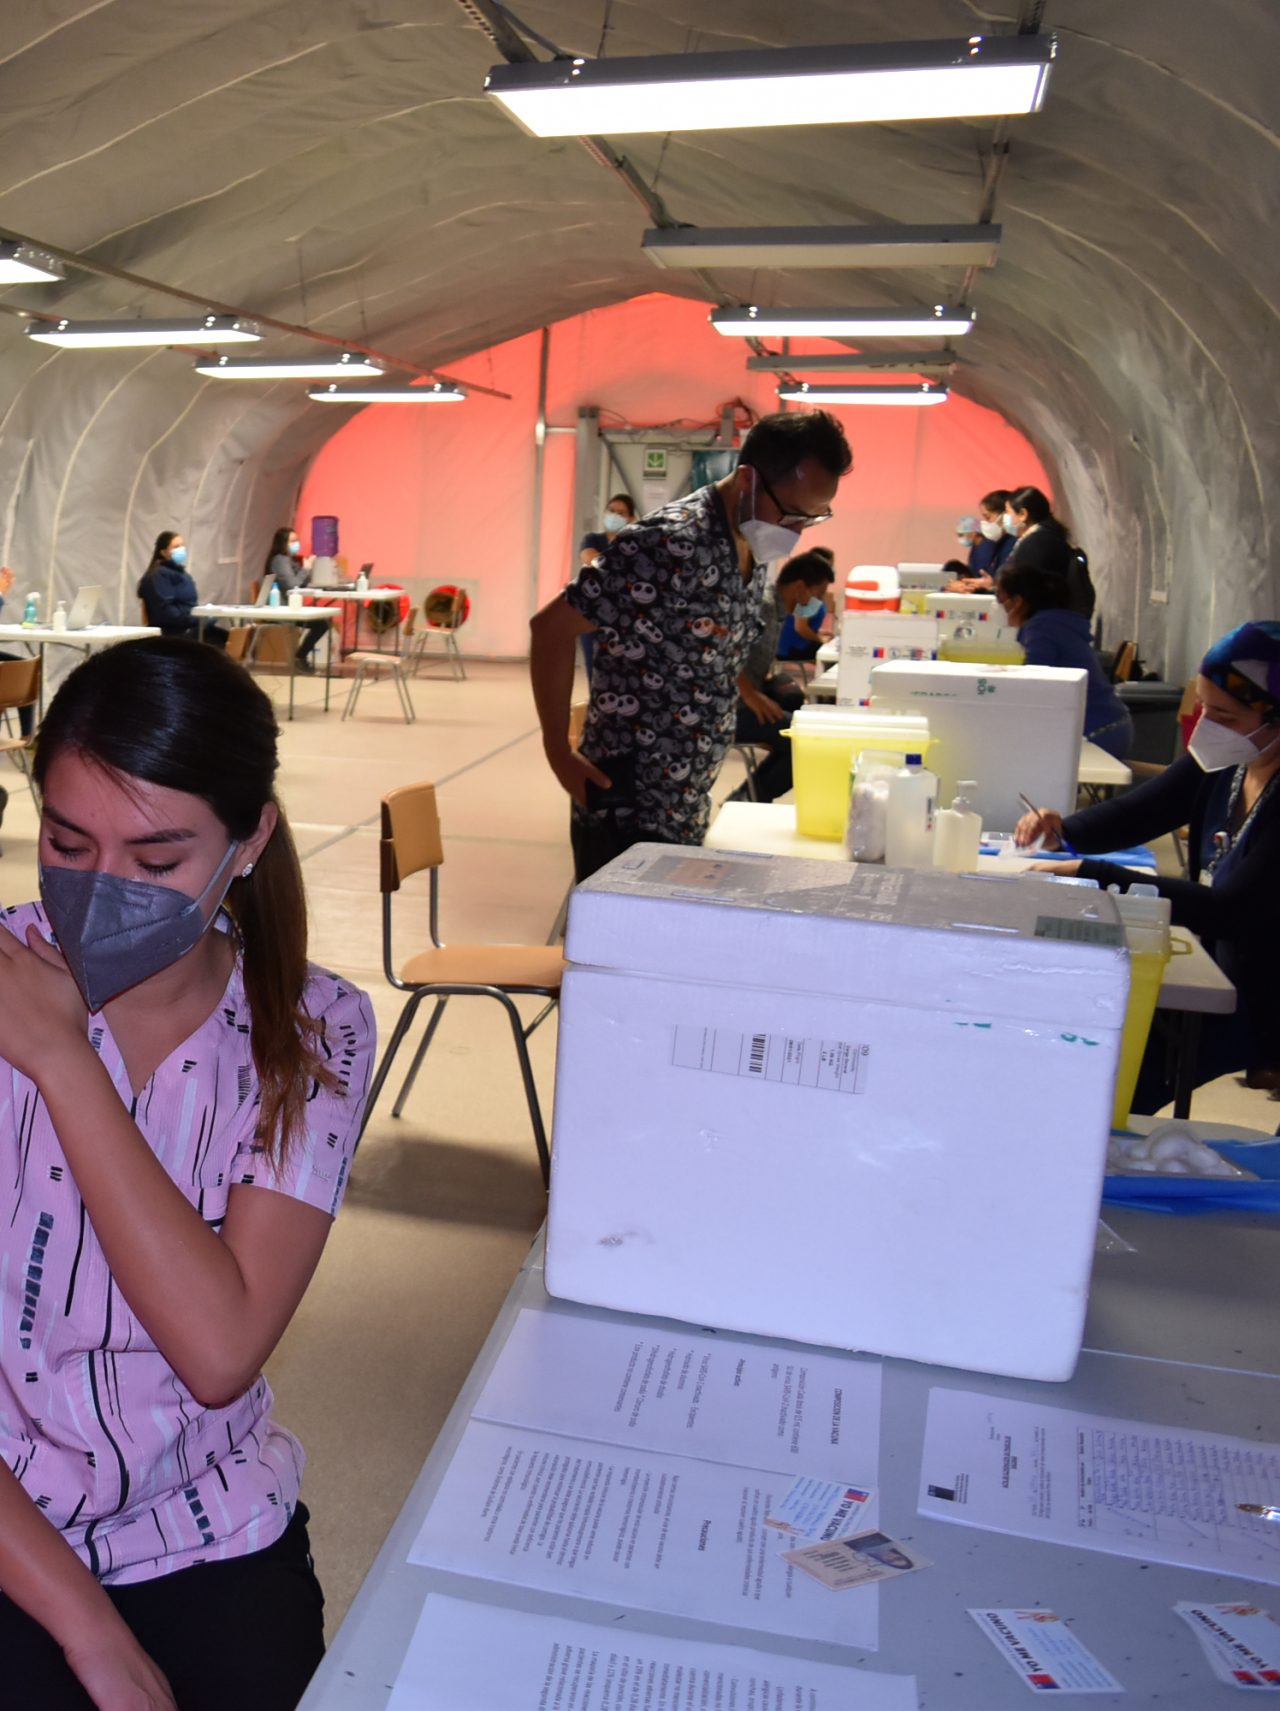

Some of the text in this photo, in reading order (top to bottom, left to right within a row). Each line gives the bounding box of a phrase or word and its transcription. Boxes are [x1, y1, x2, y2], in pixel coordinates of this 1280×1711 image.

[986, 1612, 1043, 1673] YO ME VACUNO
